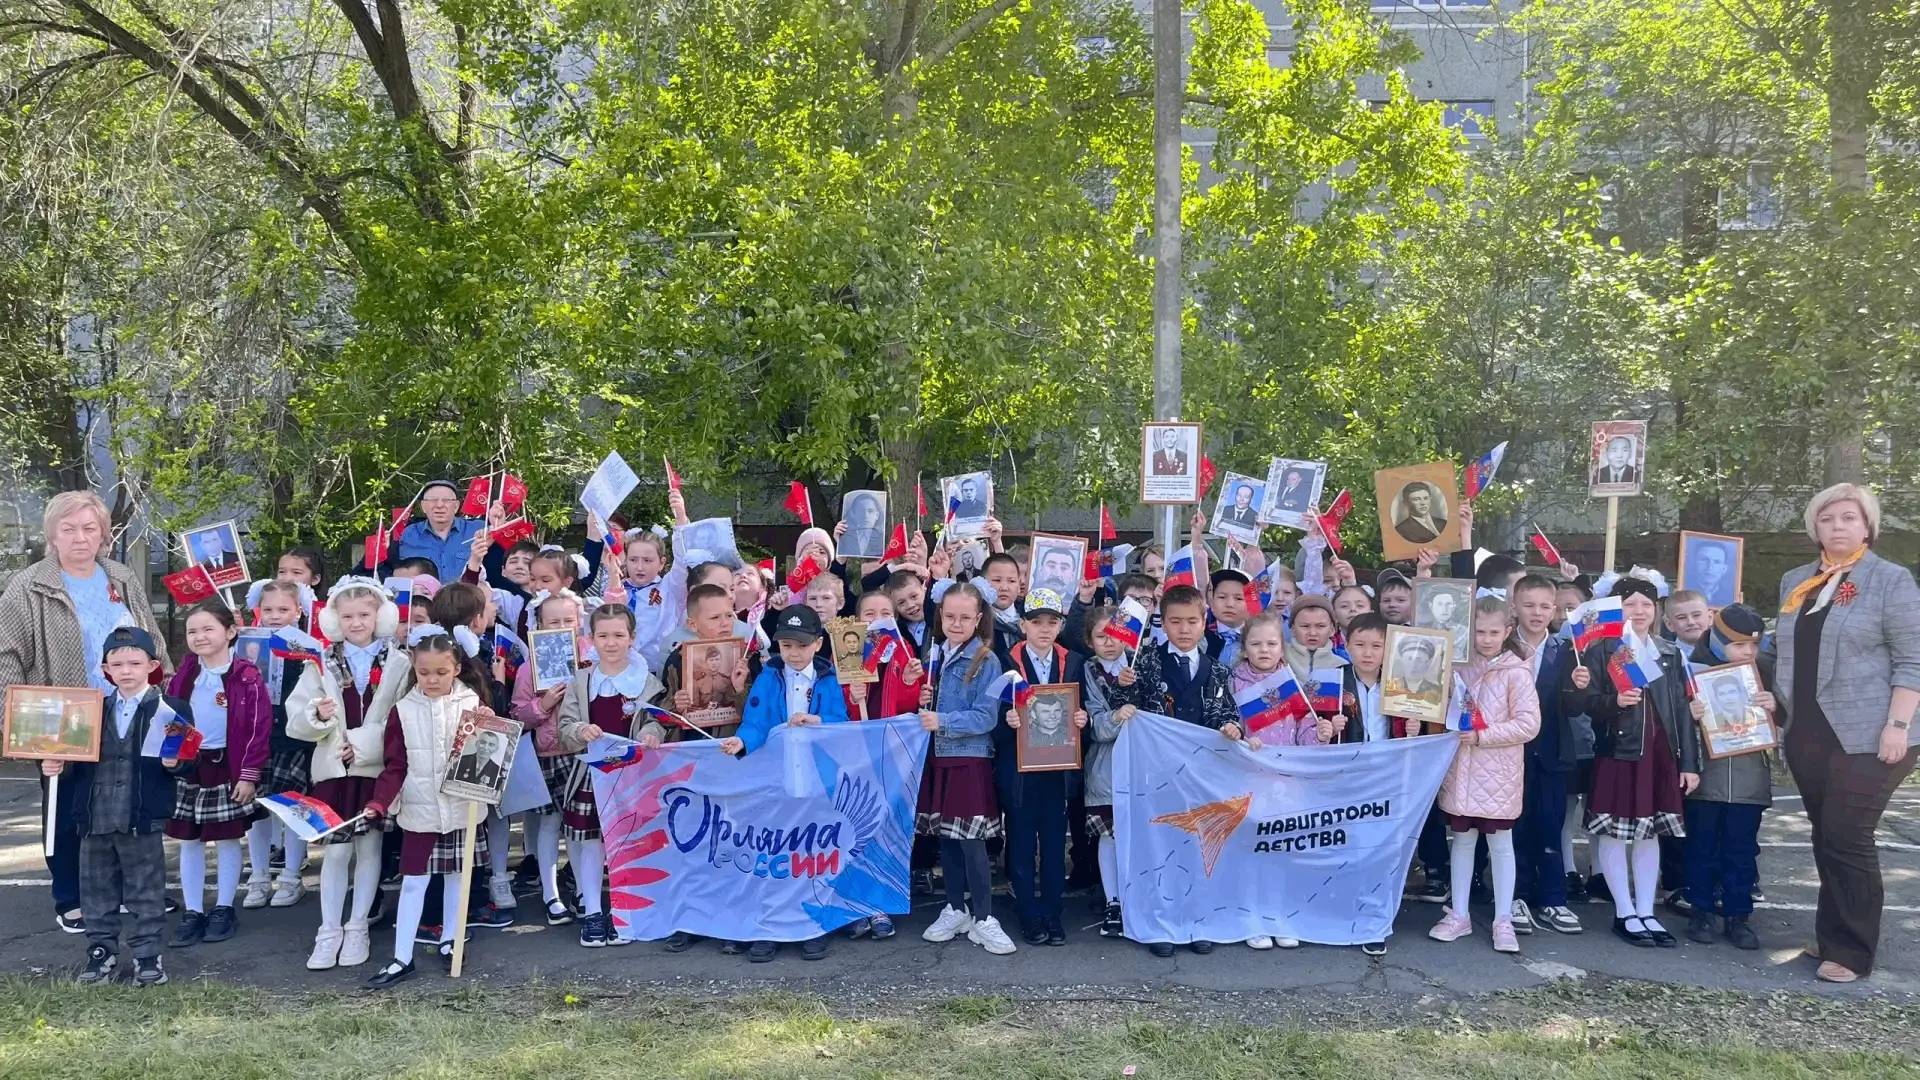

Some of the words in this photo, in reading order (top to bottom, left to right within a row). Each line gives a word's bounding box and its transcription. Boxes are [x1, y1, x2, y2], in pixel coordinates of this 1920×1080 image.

[663, 787, 842, 863] Орлята
[1256, 800, 1390, 836] НАВИГАТОРЫ
[1254, 828, 1346, 853] ДЕТСТВА
